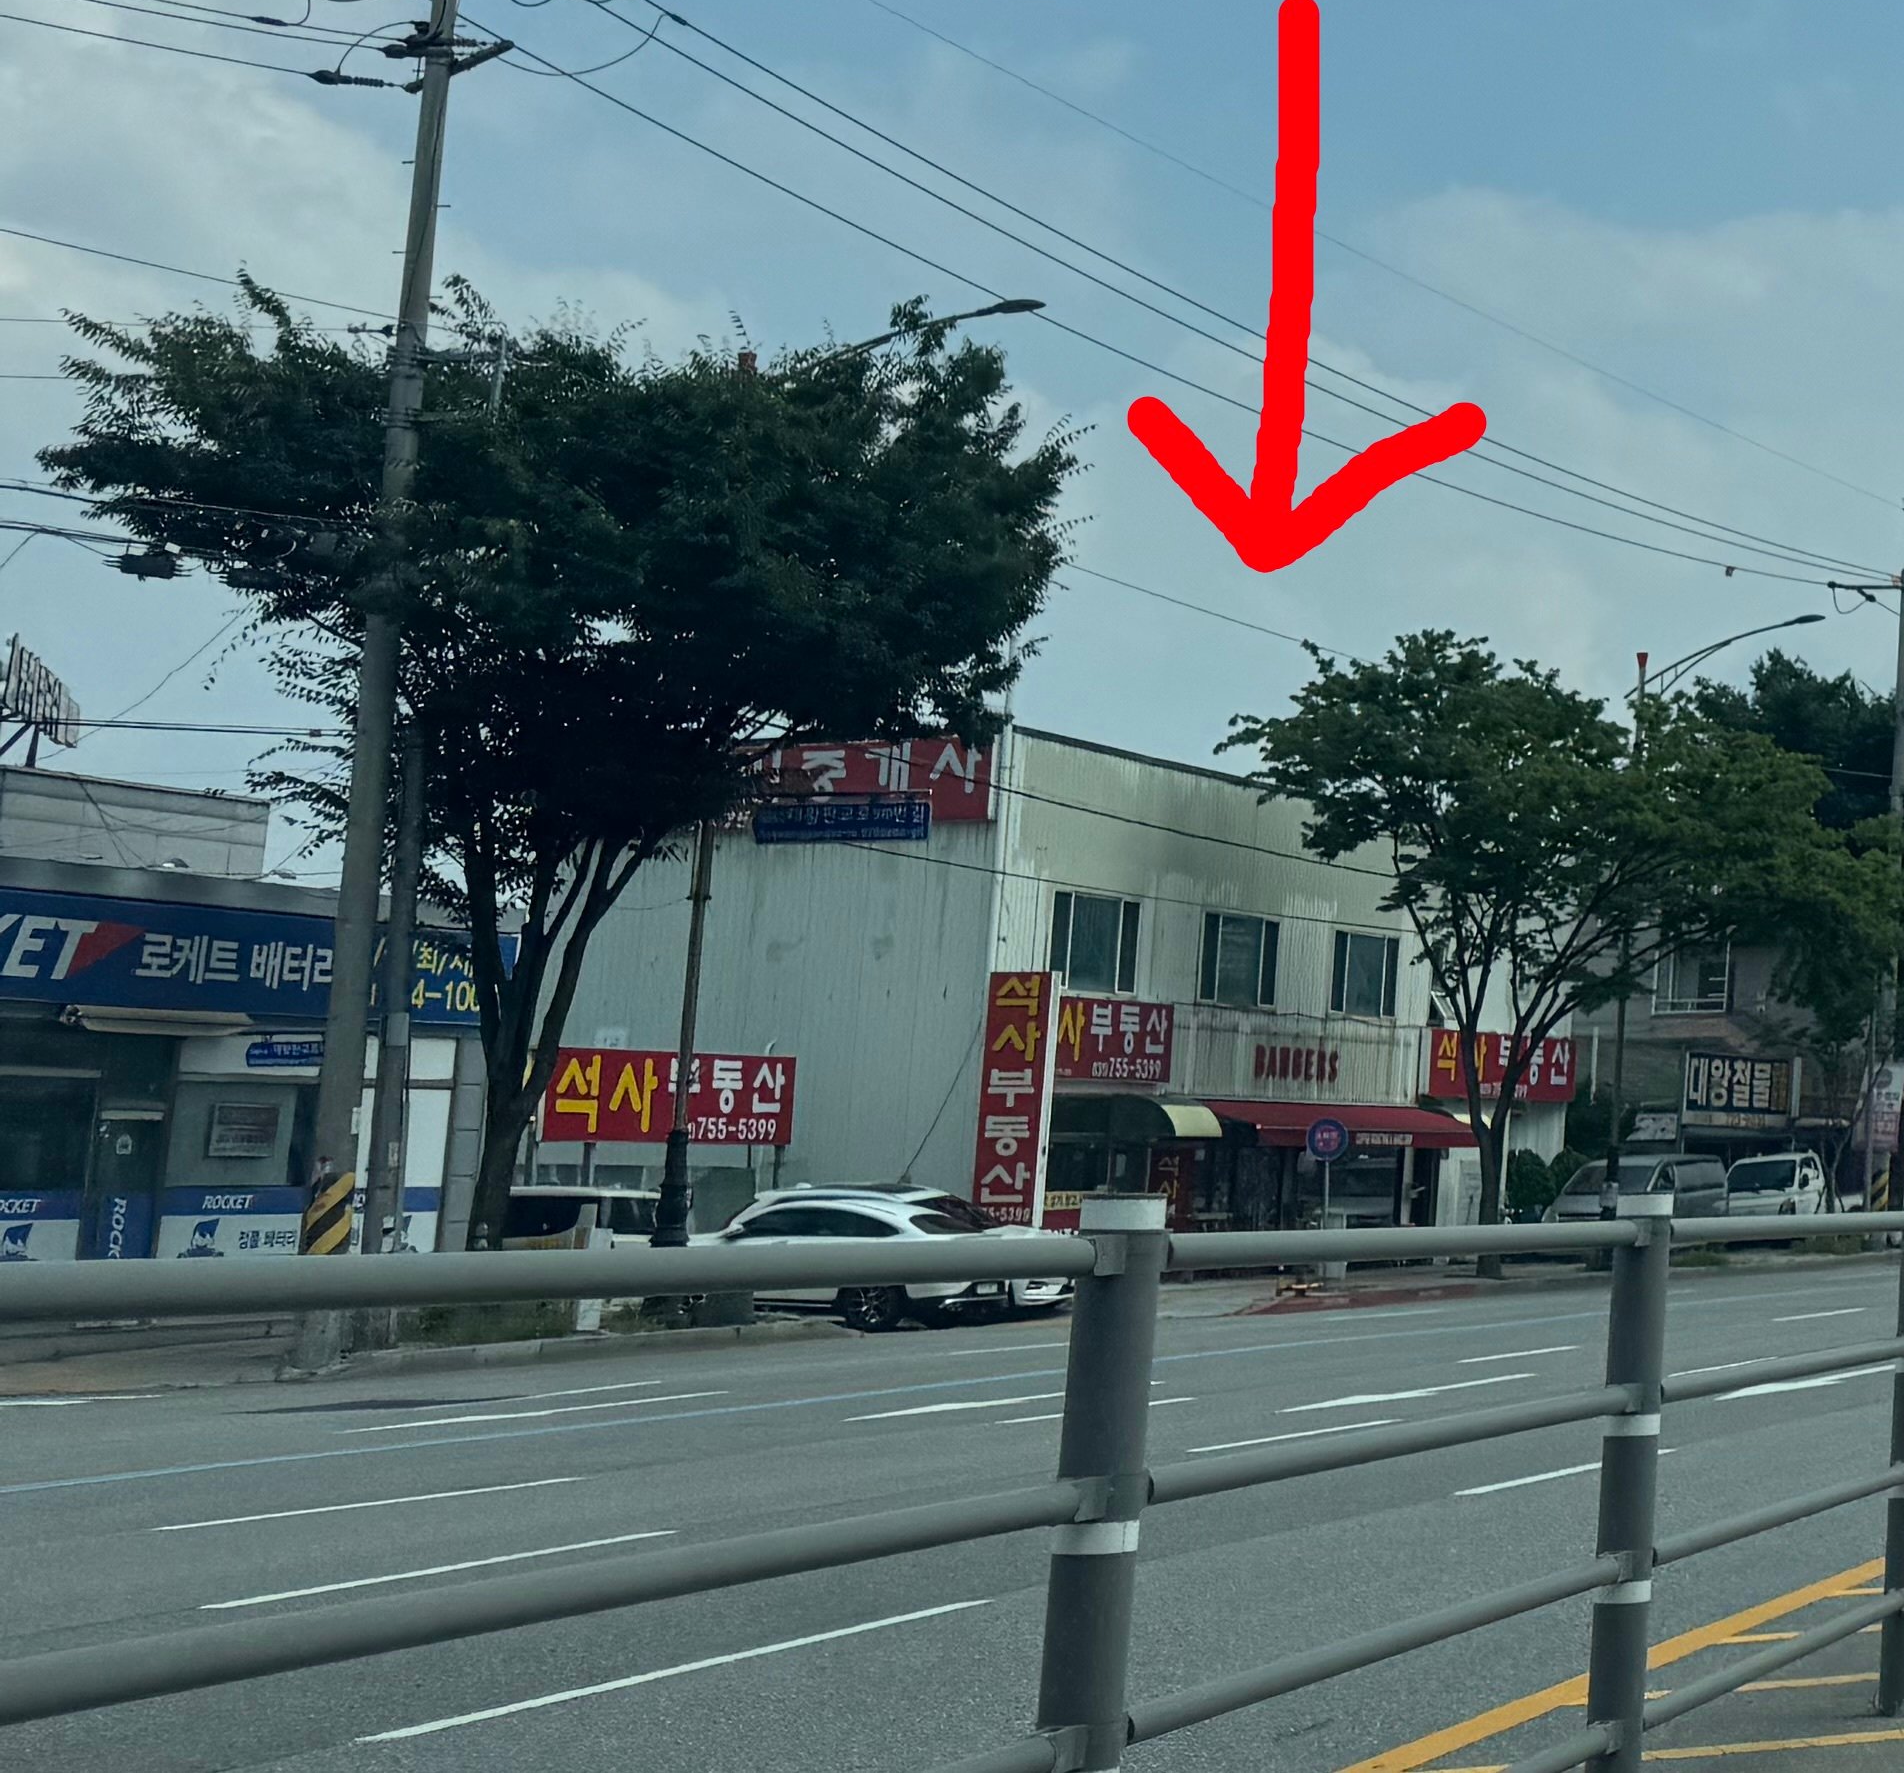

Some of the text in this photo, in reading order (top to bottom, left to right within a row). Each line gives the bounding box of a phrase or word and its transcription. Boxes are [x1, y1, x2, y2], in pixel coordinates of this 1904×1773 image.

[771, 741, 981, 801] 중개사
[135, 932, 240, 984] 로케트
[1090, 1004, 1168, 1055] 부동산
[556, 1054, 659, 1133] 석사
[980, 974, 1041, 1204] 석사 부동산
[1689, 1057, 1772, 1108] 대왕철물
[202, 1194, 255, 1211] ROCKET
